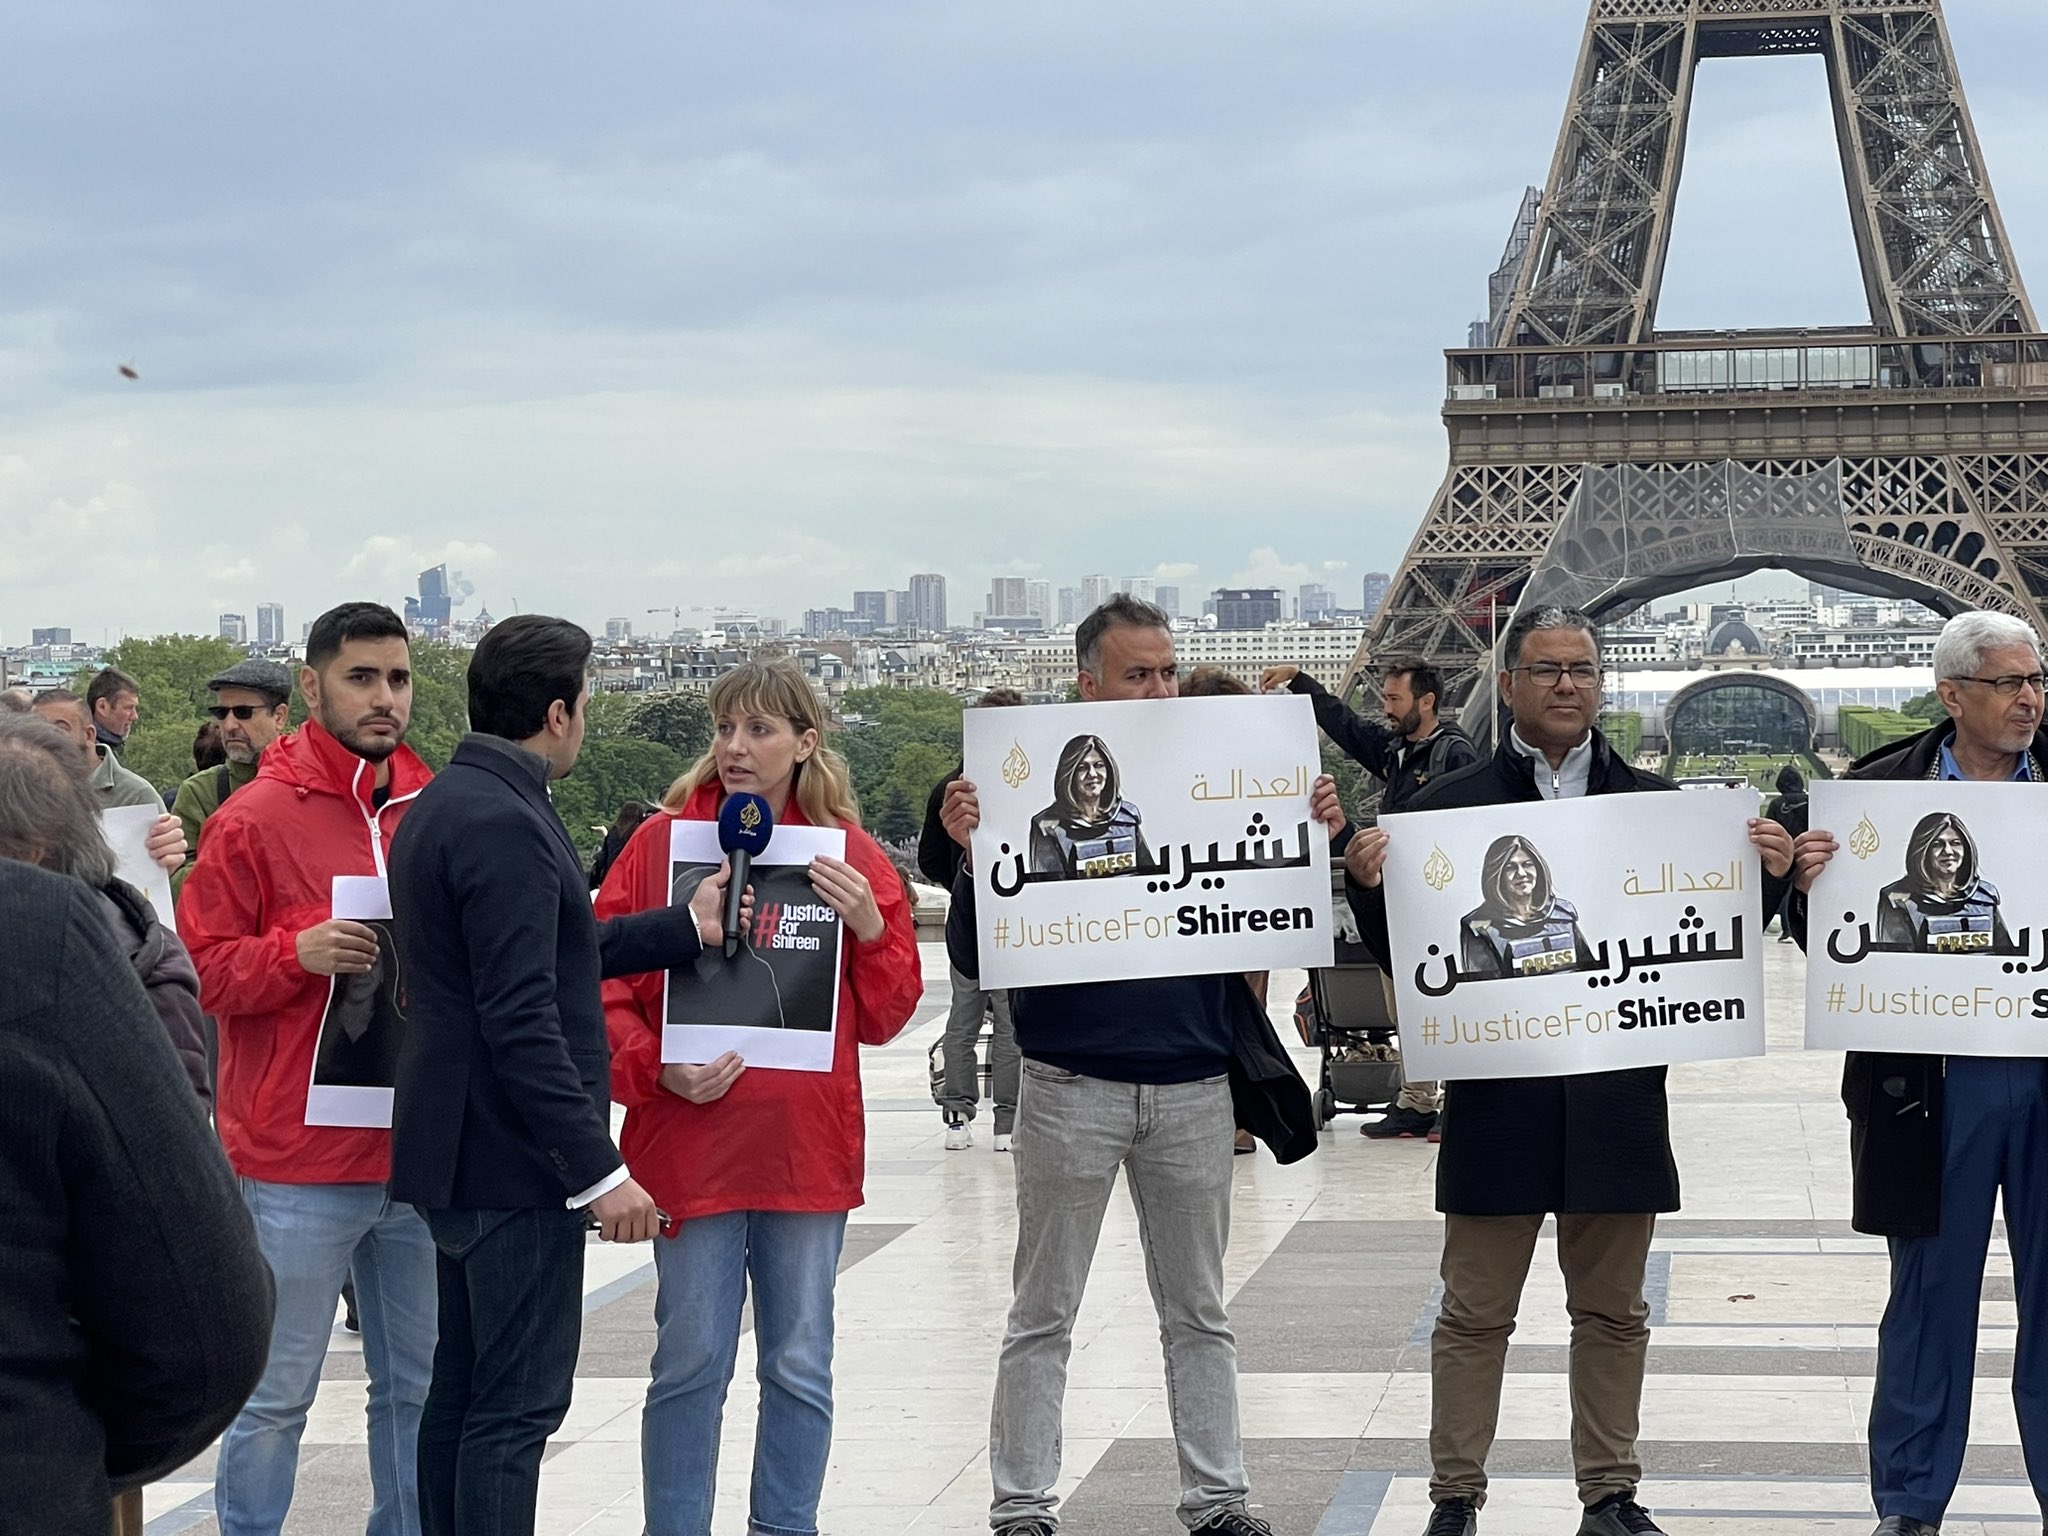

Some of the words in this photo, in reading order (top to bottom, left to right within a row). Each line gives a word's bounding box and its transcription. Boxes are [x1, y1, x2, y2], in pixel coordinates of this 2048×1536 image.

[1190, 766, 1309, 802] العدالة
[990, 813, 1311, 898] لشيرين
[1084, 853, 1133, 877] PRESS
[1623, 861, 1743, 896] العدالة
[772, 933, 820, 951] Shireen
[779, 920, 800, 935] For
[994, 904, 1314, 949] #JusticeForShireen
[1936, 933, 1990, 953] PRESS
[1415, 905, 1744, 997] لشيرين
[1521, 950, 1574, 975] PRESS
[1421, 995, 1745, 1046] #JusticeForShireen
